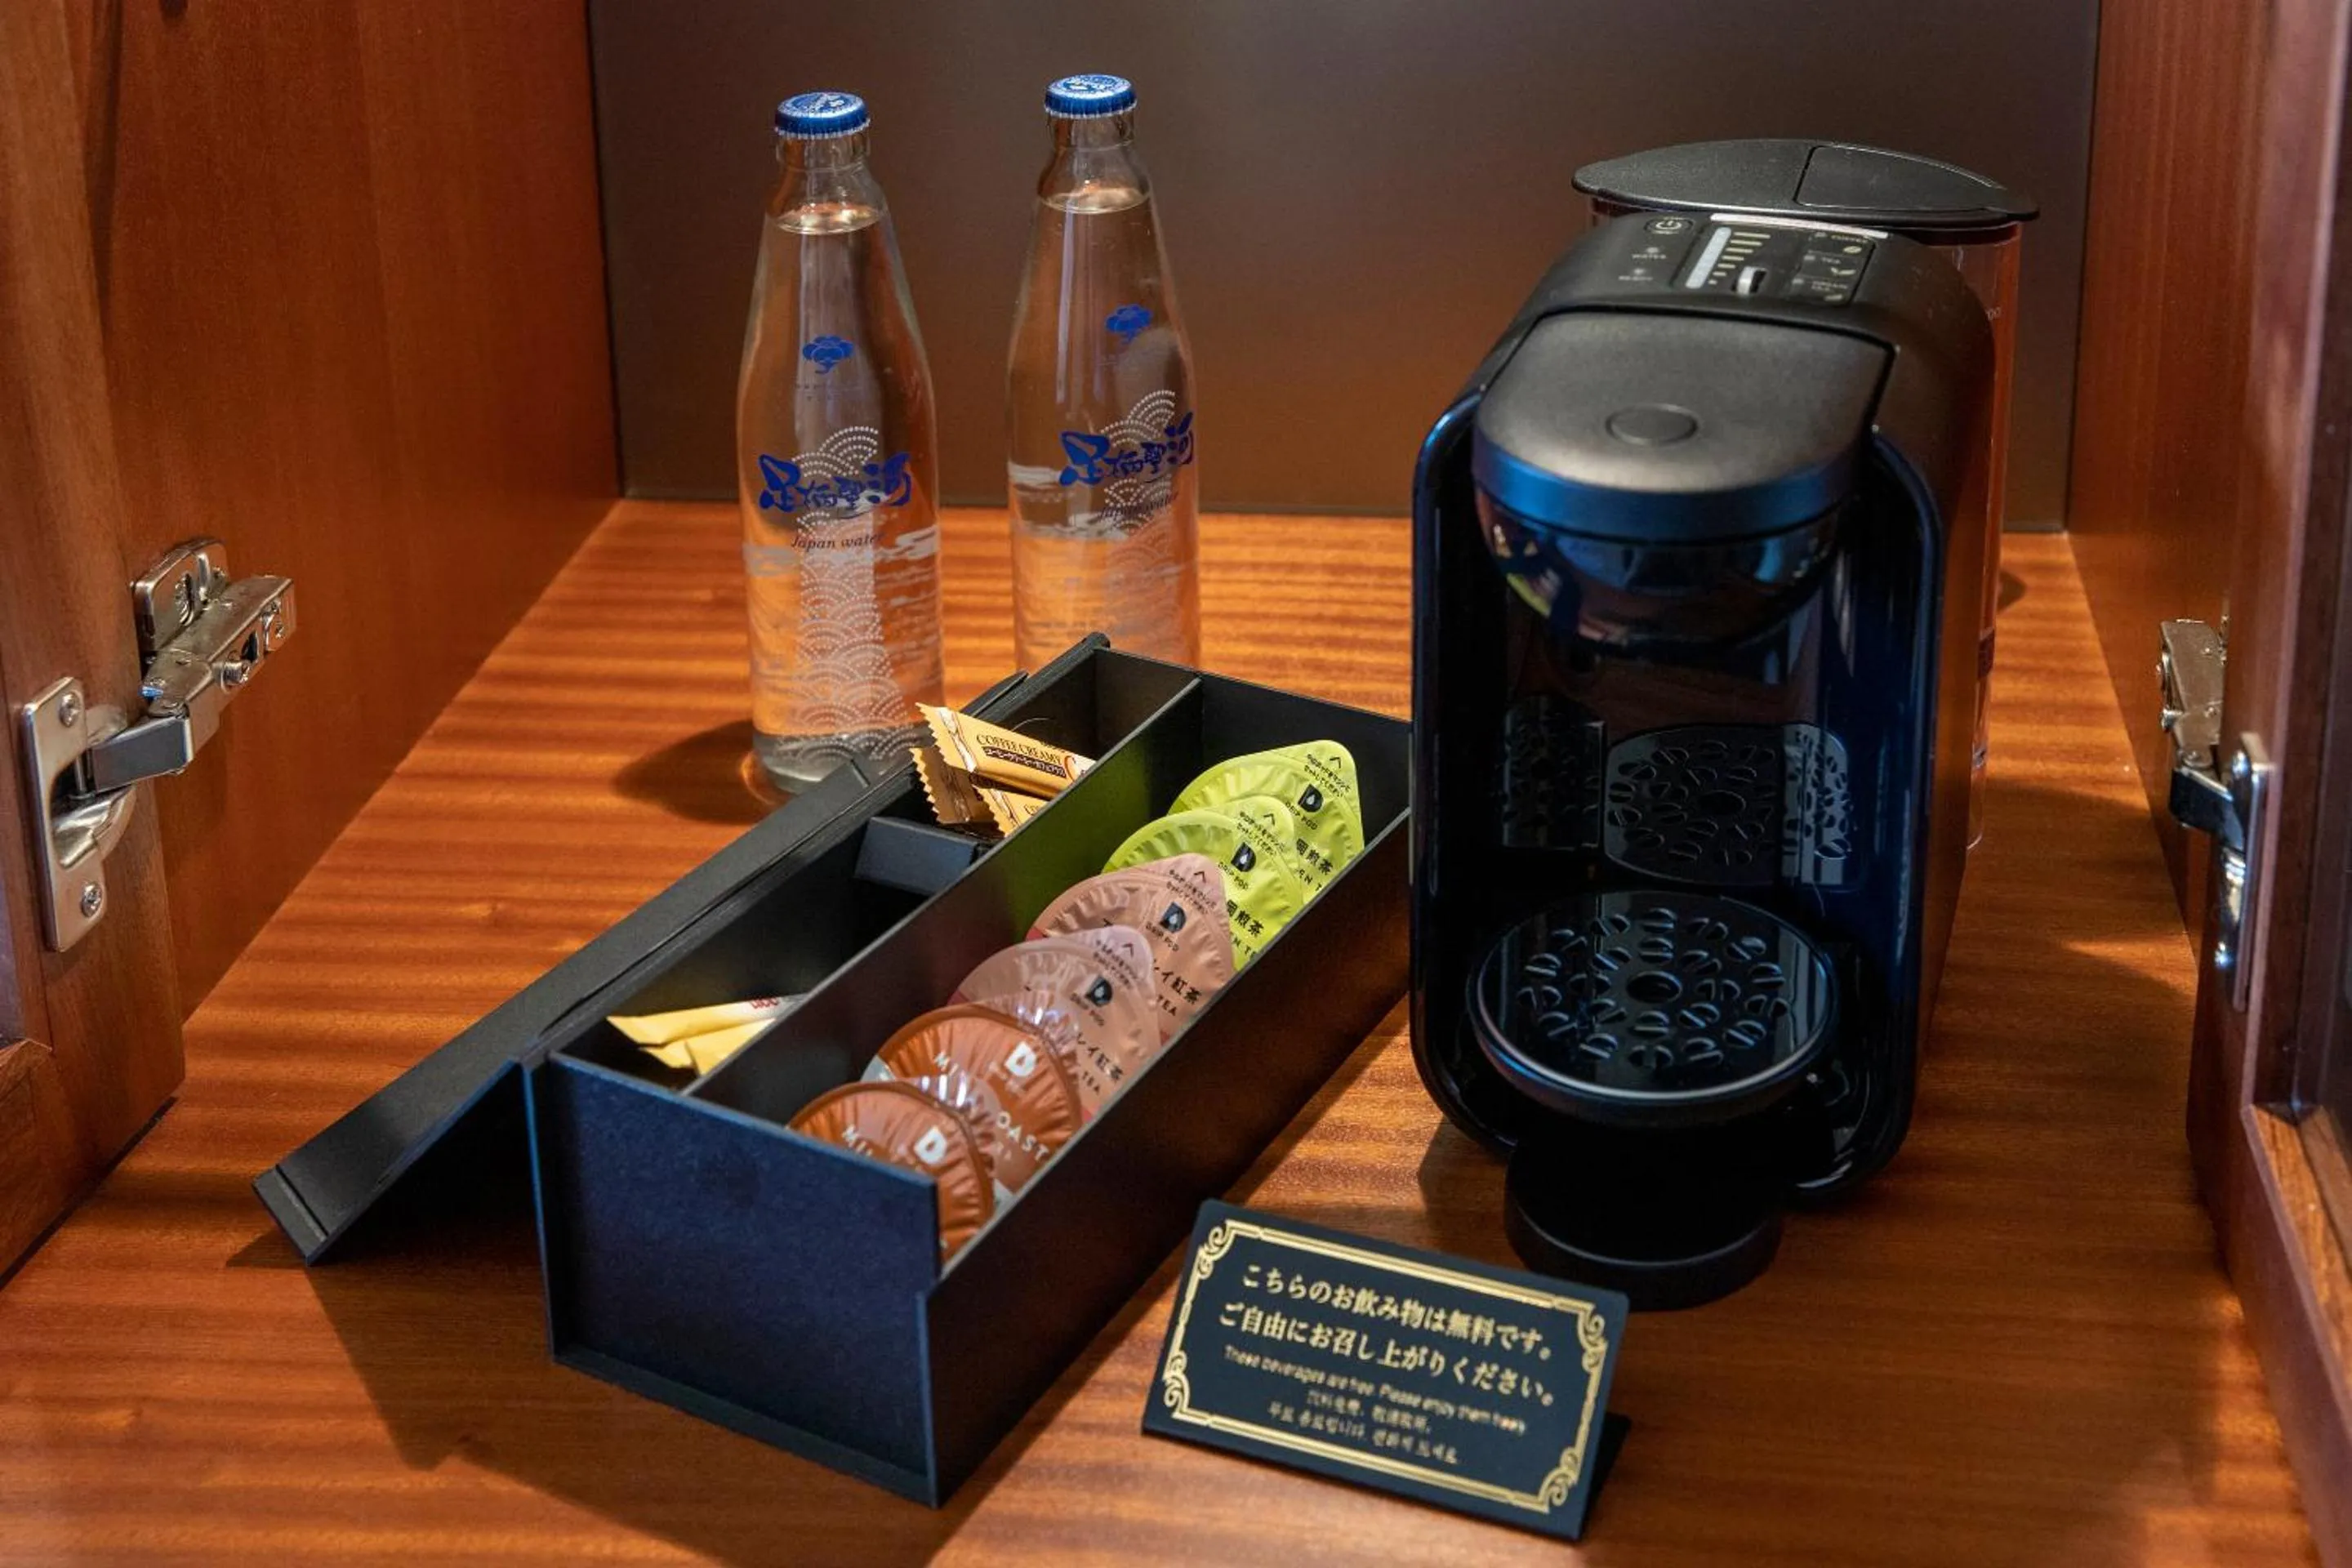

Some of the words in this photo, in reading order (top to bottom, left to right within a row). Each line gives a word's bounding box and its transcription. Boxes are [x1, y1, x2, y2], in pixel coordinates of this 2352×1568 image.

[791, 533, 836, 552] Japan
[840, 532, 885, 548] water
[1157, 994, 1177, 1017] TEA
[996, 1111, 1049, 1163] OAST
[1243, 1264, 1552, 1361] こちらのお飲み物は無料です。
[1219, 1302, 1553, 1407] ご自由にお召し上がりください。
